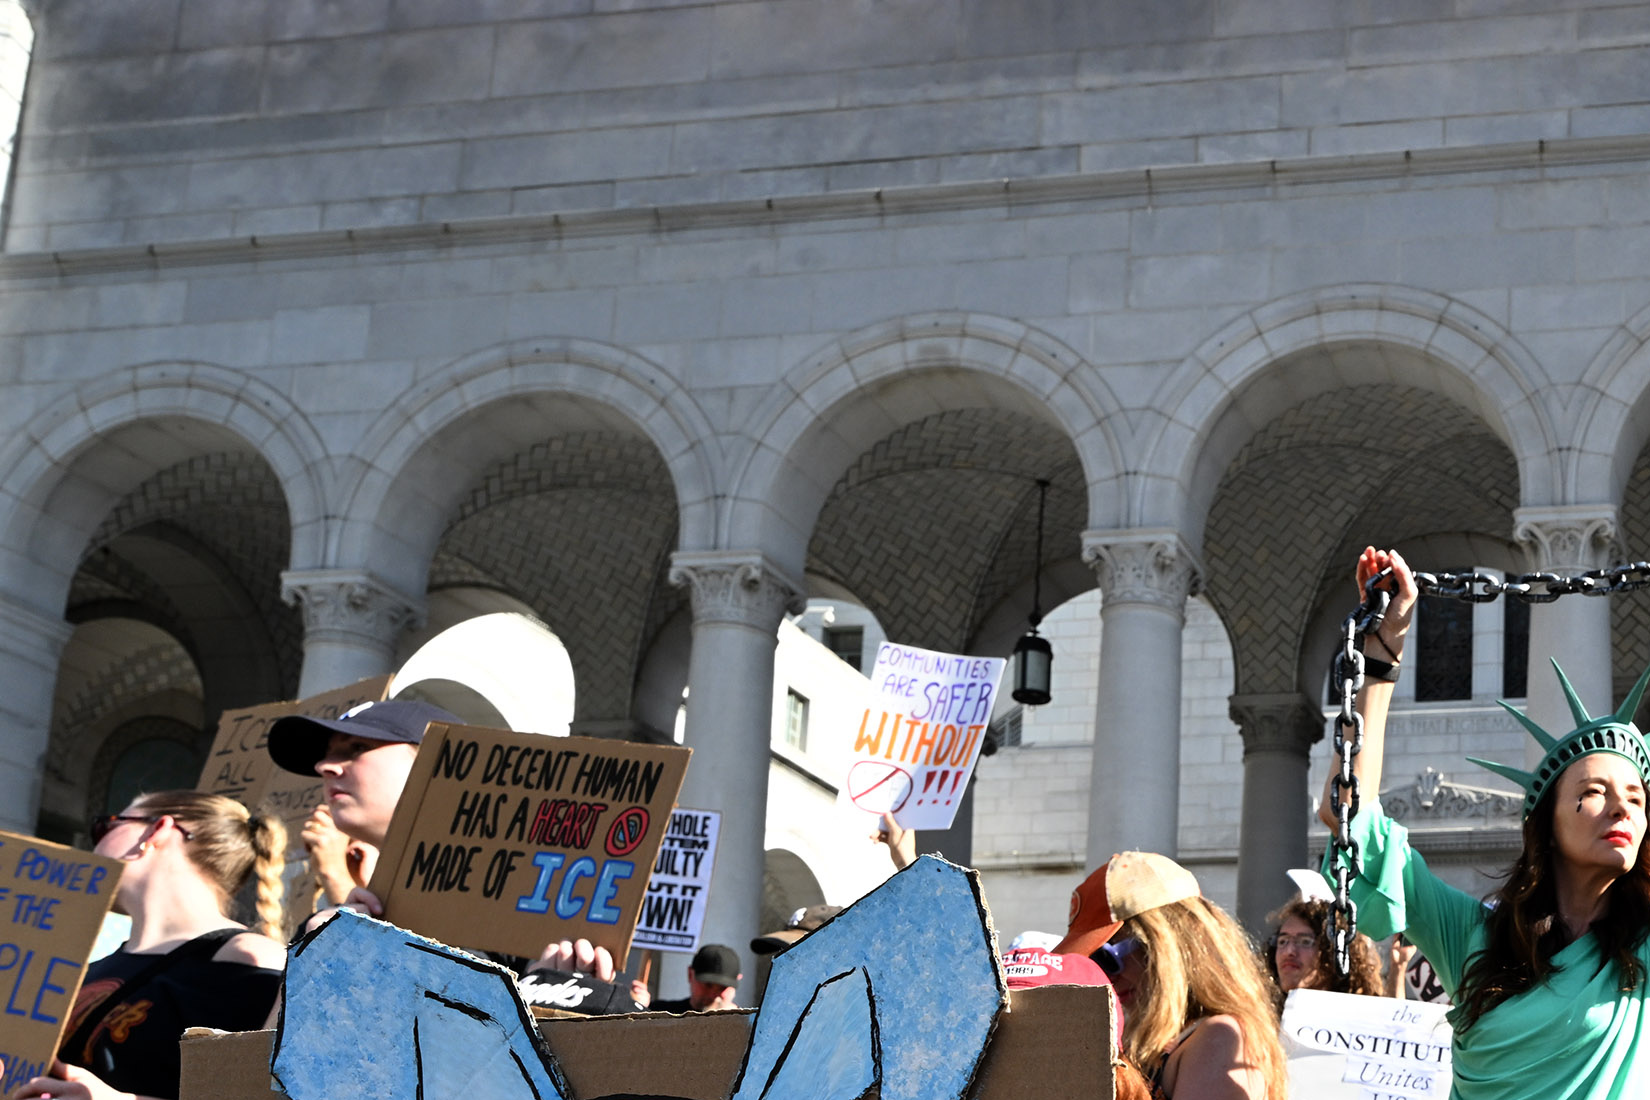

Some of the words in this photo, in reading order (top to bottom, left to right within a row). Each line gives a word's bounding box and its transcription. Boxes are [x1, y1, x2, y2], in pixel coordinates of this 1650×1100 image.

[878, 645, 992, 679] COMMUNITIES
[882, 673, 918, 697] ARE
[911, 682, 992, 724] SAFER
[854, 708, 984, 767] WITHOUT
[433, 739, 479, 781] NO
[481, 744, 579, 792] DECENT
[572, 753, 664, 804] HUMAN
[450, 790, 508, 839] HAS
[505, 797, 530, 842] A
[527, 799, 608, 850] HEART
[666, 813, 711, 838] HOLE
[14, 847, 108, 894] POWER
[654, 848, 704, 878] UILTY
[406, 841, 482, 893] MADE
[483, 848, 525, 900] OF
[516, 851, 635, 925] ICE
[648, 881, 678, 895] UT
[12, 893, 61, 930] THE
[637, 895, 693, 931] WN!
[1392, 1005, 1422, 1024] the
[1297, 1026, 1453, 1064] CONSTITUT
[1359, 1062, 1433, 1090] Unites
